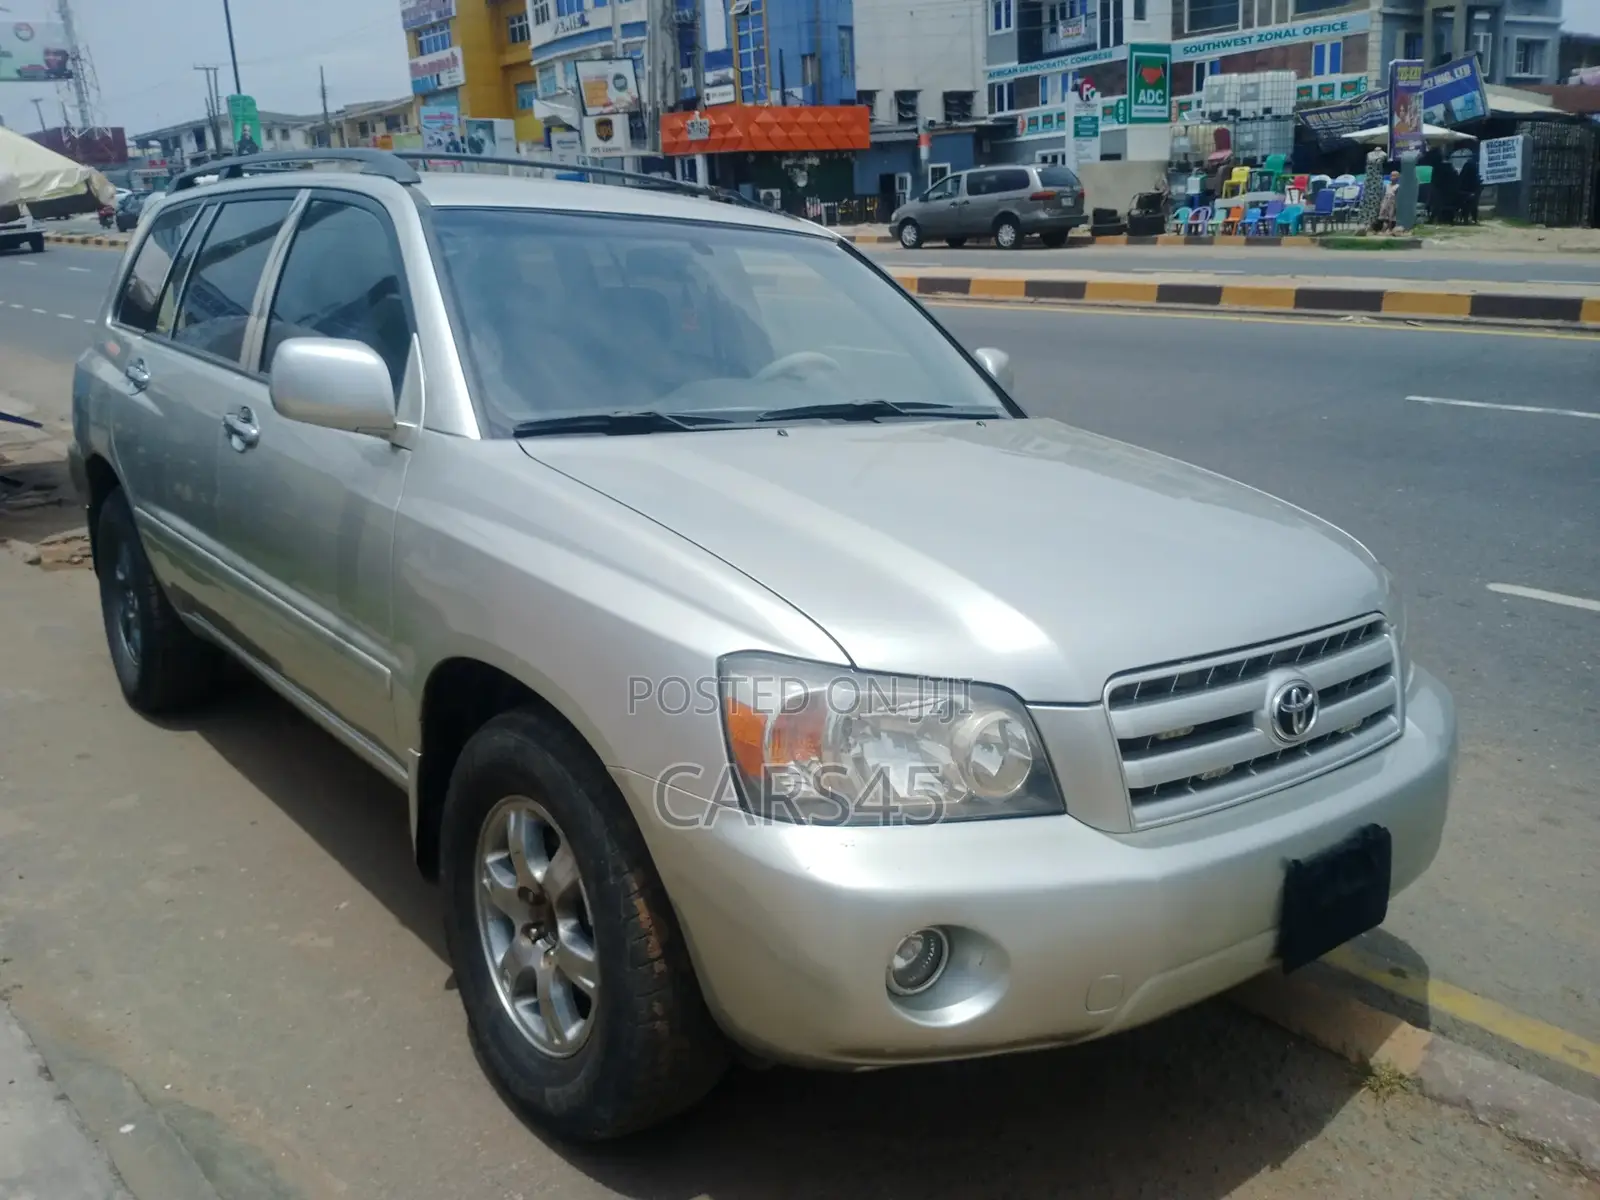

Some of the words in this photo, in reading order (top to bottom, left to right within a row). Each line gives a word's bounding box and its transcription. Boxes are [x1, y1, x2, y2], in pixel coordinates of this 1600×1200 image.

[1183, 35, 1253, 55] SOUTHWEST
[1257, 28, 1299, 43] ZONAL
[1302, 21, 1349, 36] OFFICE
[988, 66, 1018, 79] AFRICAN
[1020, 60, 1068, 73] DEMOCRATIC
[1070, 51, 1113, 64] CONGRESS
[1138, 89, 1164, 104] ADC
